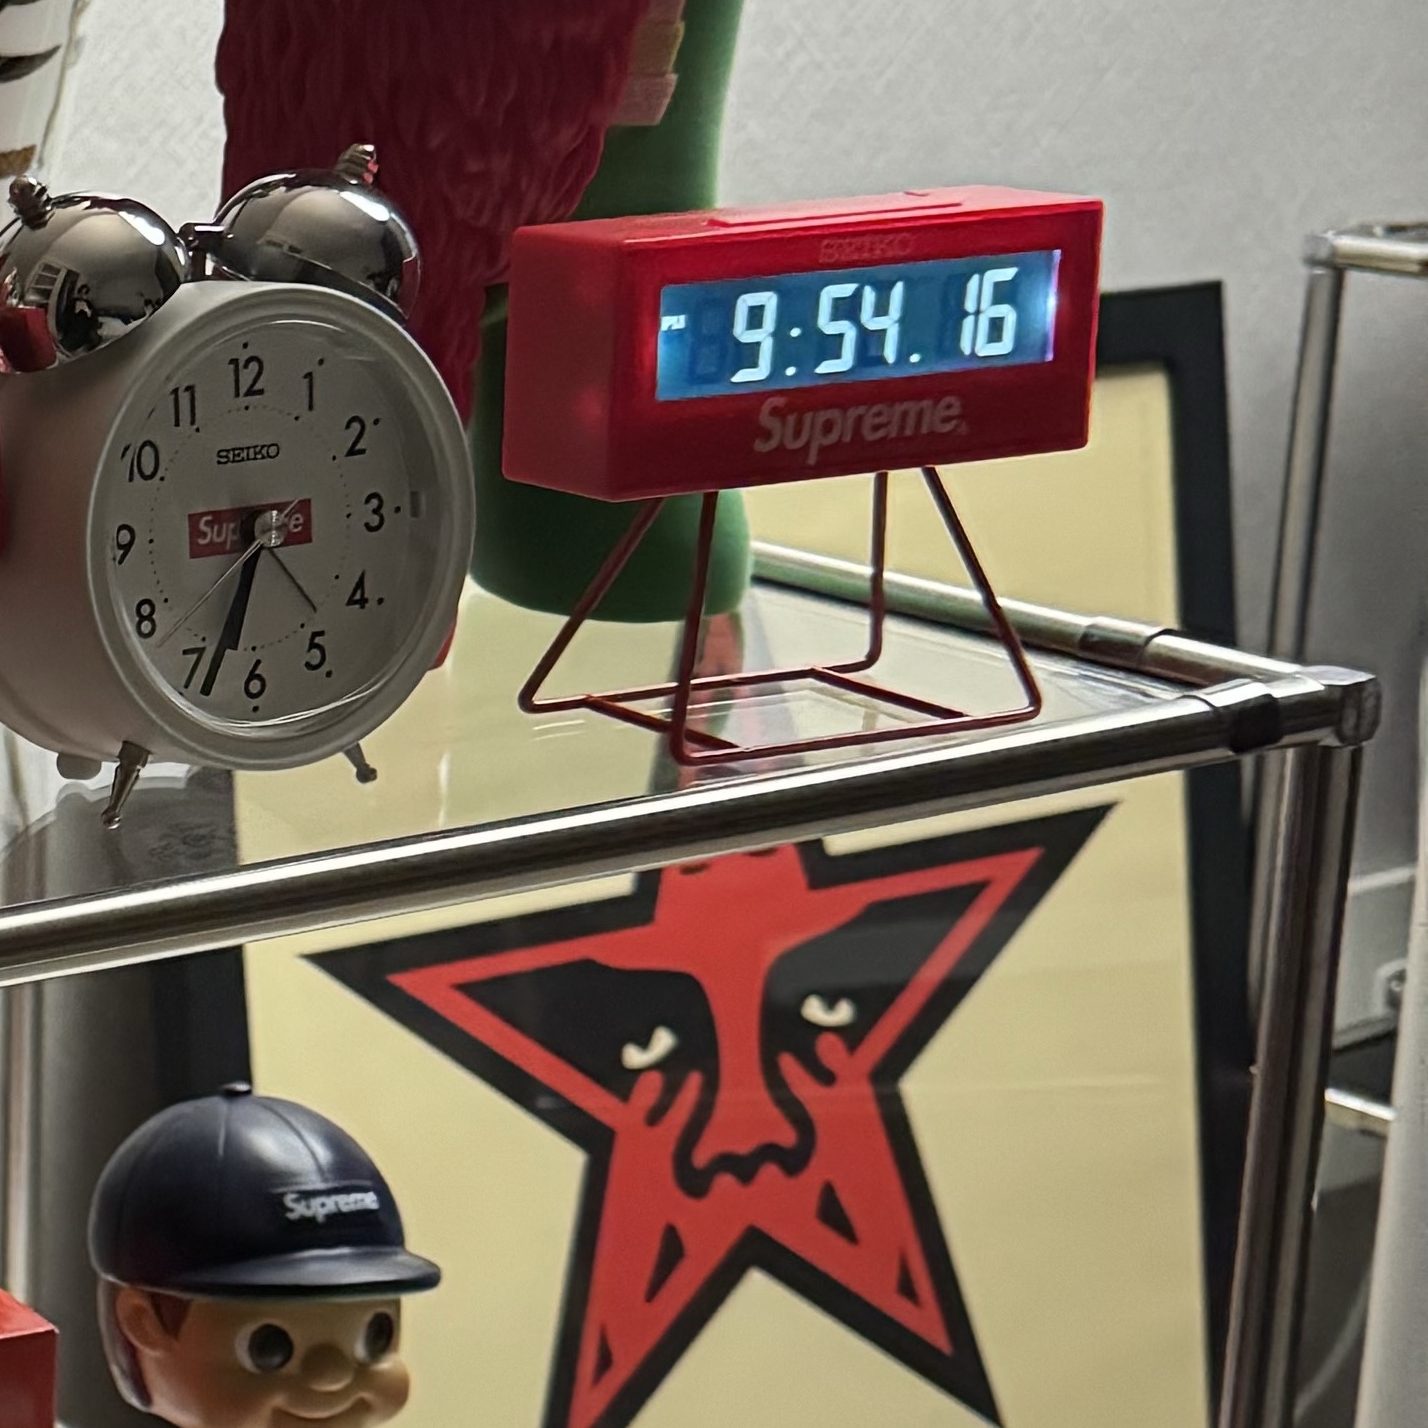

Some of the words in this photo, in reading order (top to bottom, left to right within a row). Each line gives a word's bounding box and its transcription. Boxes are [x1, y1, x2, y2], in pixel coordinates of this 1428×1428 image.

[228, 356, 265, 398] 12
[302, 372, 315, 411] 1
[170, 385, 197, 428] 11
[345, 415, 367, 457] 2
[753, 395, 963, 466] Supreme
[127, 439, 160, 483] 10
[216, 443, 281, 465] SEIKO
[198, 513, 304, 550] Supe
[364, 492, 385, 532] 3
[115, 524, 136, 565] 9
[346, 570, 367, 609] 4
[135, 598, 157, 638] 8
[182, 647, 207, 690] 7
[304, 631, 327, 671] 5
[244, 659, 266, 699] 6
[283, 1189, 380, 1222] Supreme
